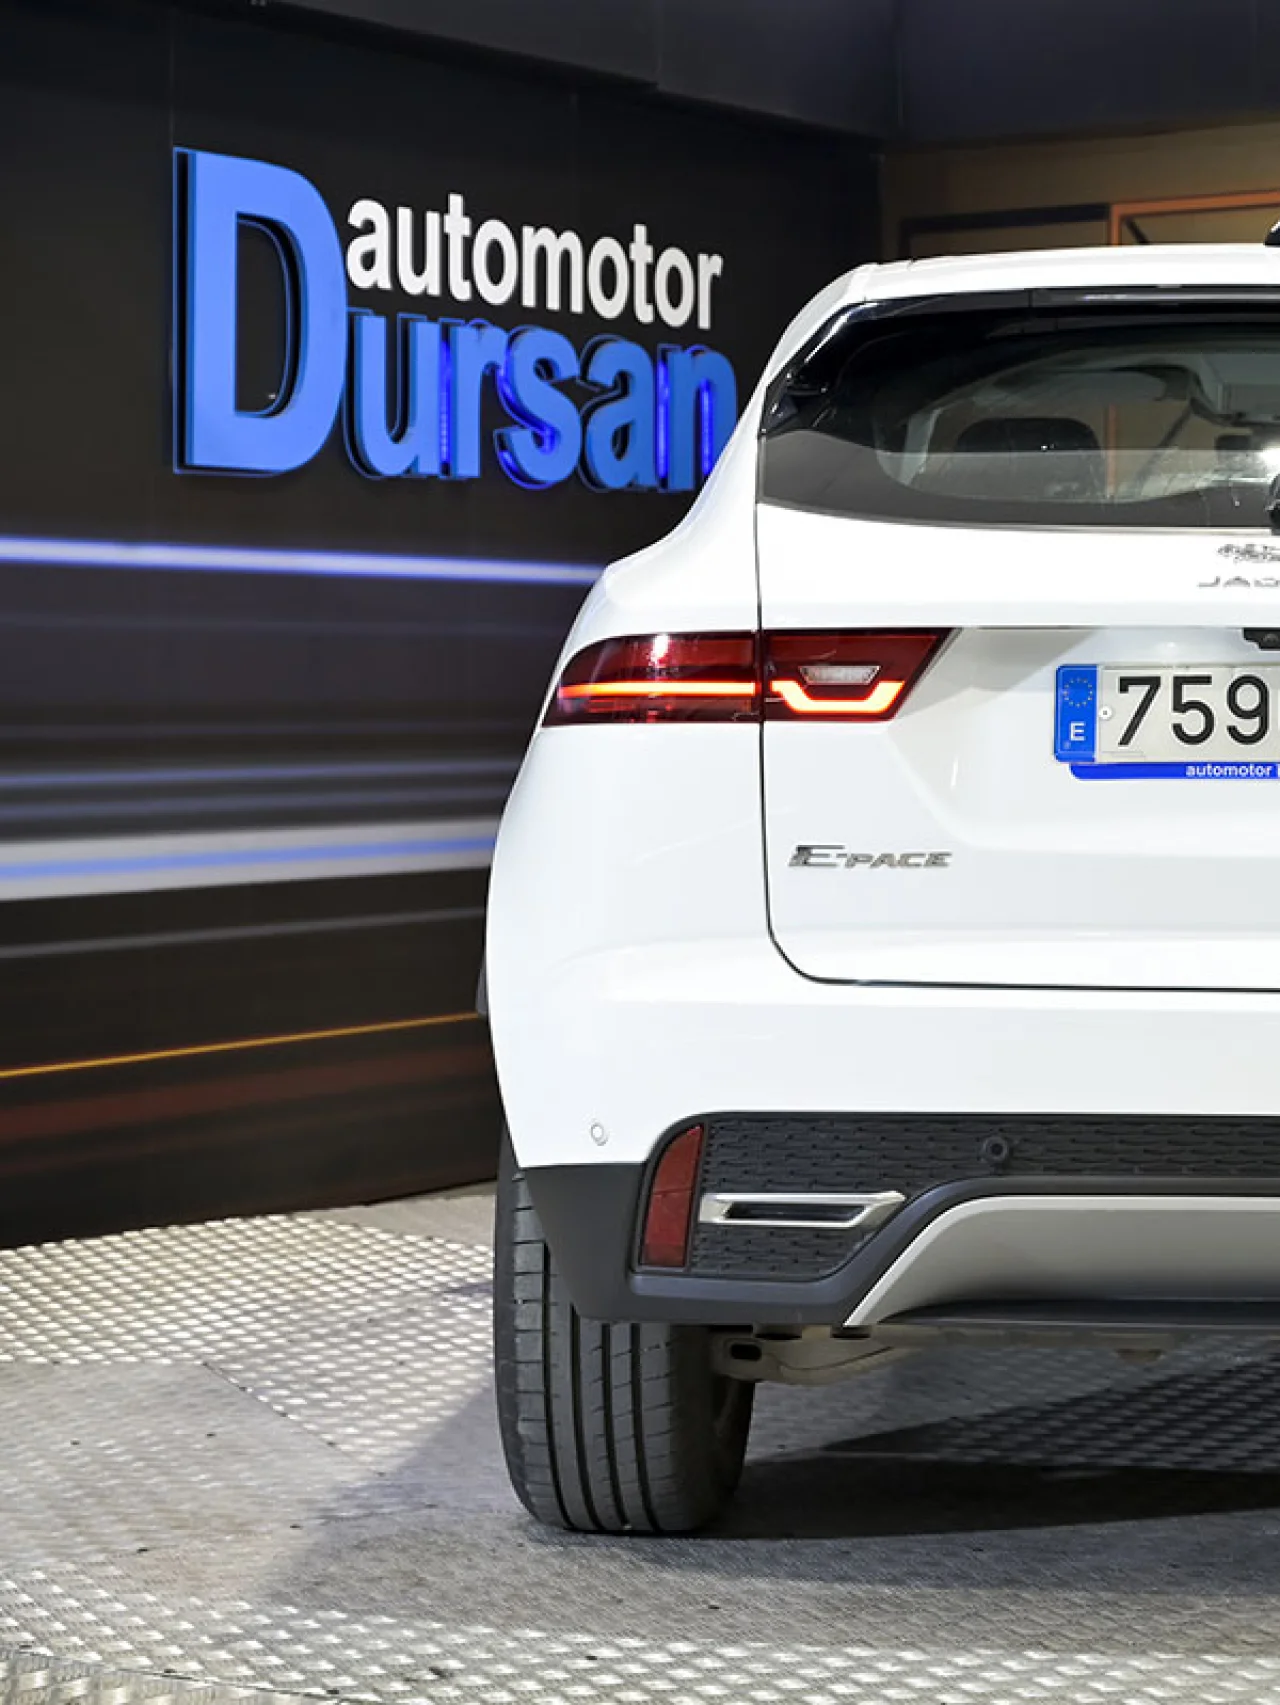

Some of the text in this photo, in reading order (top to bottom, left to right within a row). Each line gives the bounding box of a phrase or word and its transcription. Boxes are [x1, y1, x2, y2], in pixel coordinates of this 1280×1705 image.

[346, 193, 723, 329] automotor
[173, 147, 738, 493] Dursan
[1069, 721, 1087, 742] E
[1185, 763, 1273, 777] automotor
